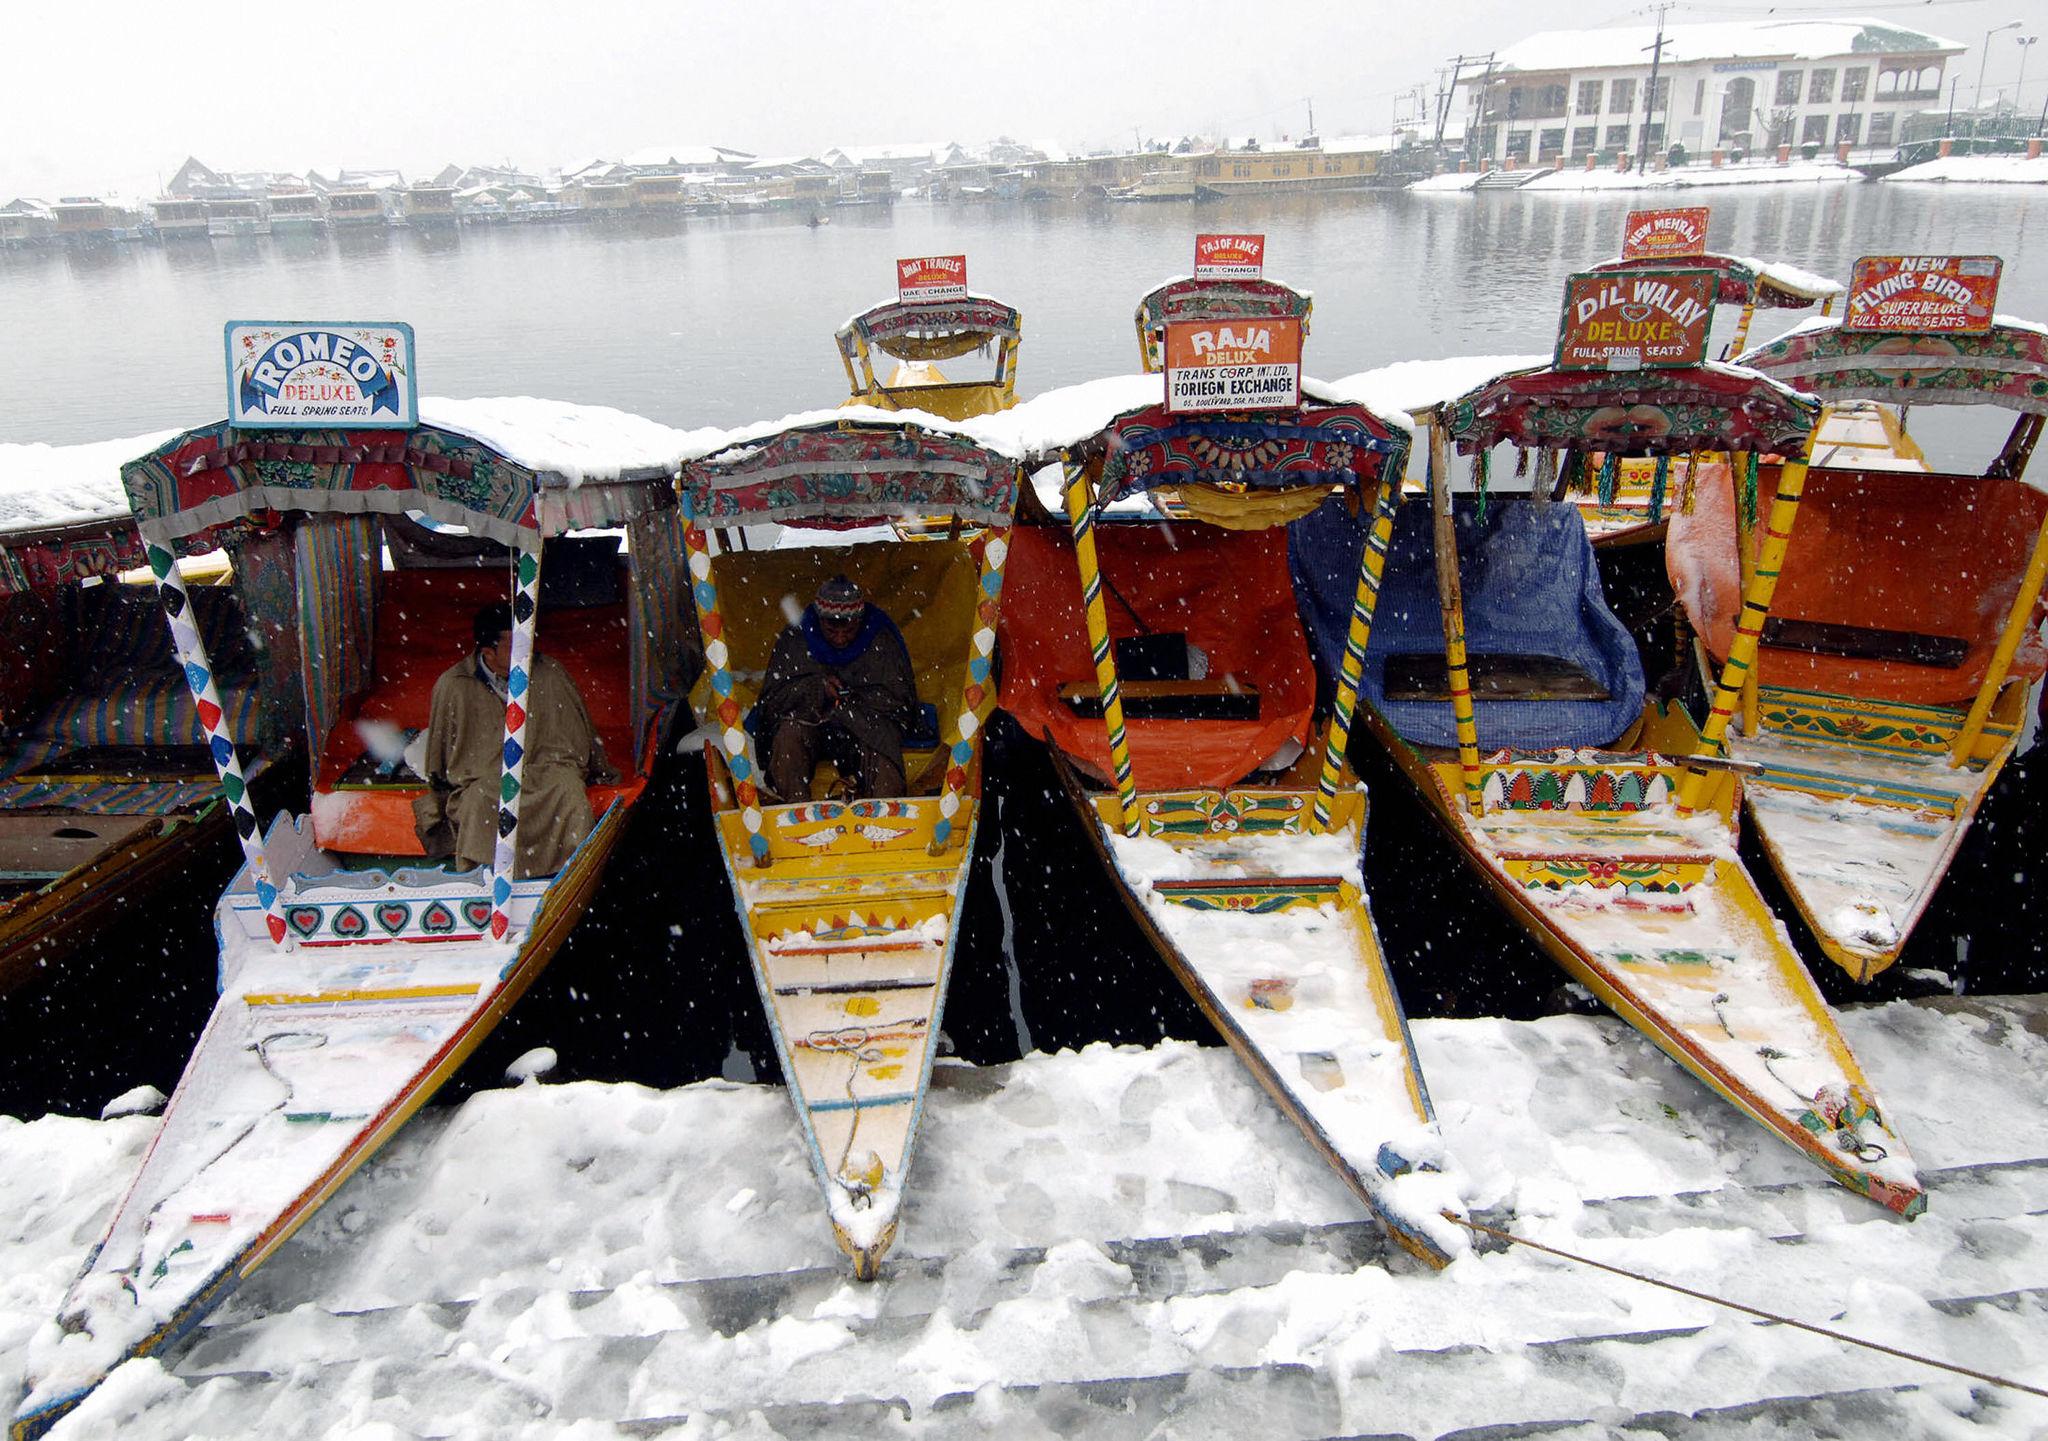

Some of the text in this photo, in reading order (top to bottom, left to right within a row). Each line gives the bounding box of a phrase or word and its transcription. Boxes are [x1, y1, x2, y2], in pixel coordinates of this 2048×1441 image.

[1629, 218, 1701, 246] NEW MEHRAJ
[1201, 238, 1259, 256] TAJ OF LAKE
[924, 258, 960, 272] TRAVELS
[1899, 258, 1949, 272] NEW
[928, 286, 964, 294] CHANGE
[1850, 272, 1972, 314] FLYING BIRD
[1577, 281, 1708, 328] DIL WALAY
[1879, 301, 1964, 315] SUPER DELUXE
[1850, 315, 1966, 327] FULL SPRING SEATS
[1587, 321, 1673, 342] DELUXE
[1191, 327, 1270, 356] RAJA
[1206, 350, 1257, 365] DELUX
[1573, 346, 1684, 358] FULL SPRING SEATS
[254, 333, 377, 388] ROMEO
[1177, 368, 1216, 380] TRANS
[284, 384, 356, 401] DELUXE
[1174, 378, 1292, 396] FORIEGN EXCHANGE
[271, 405, 368, 416] FULL SPRING SEATS
